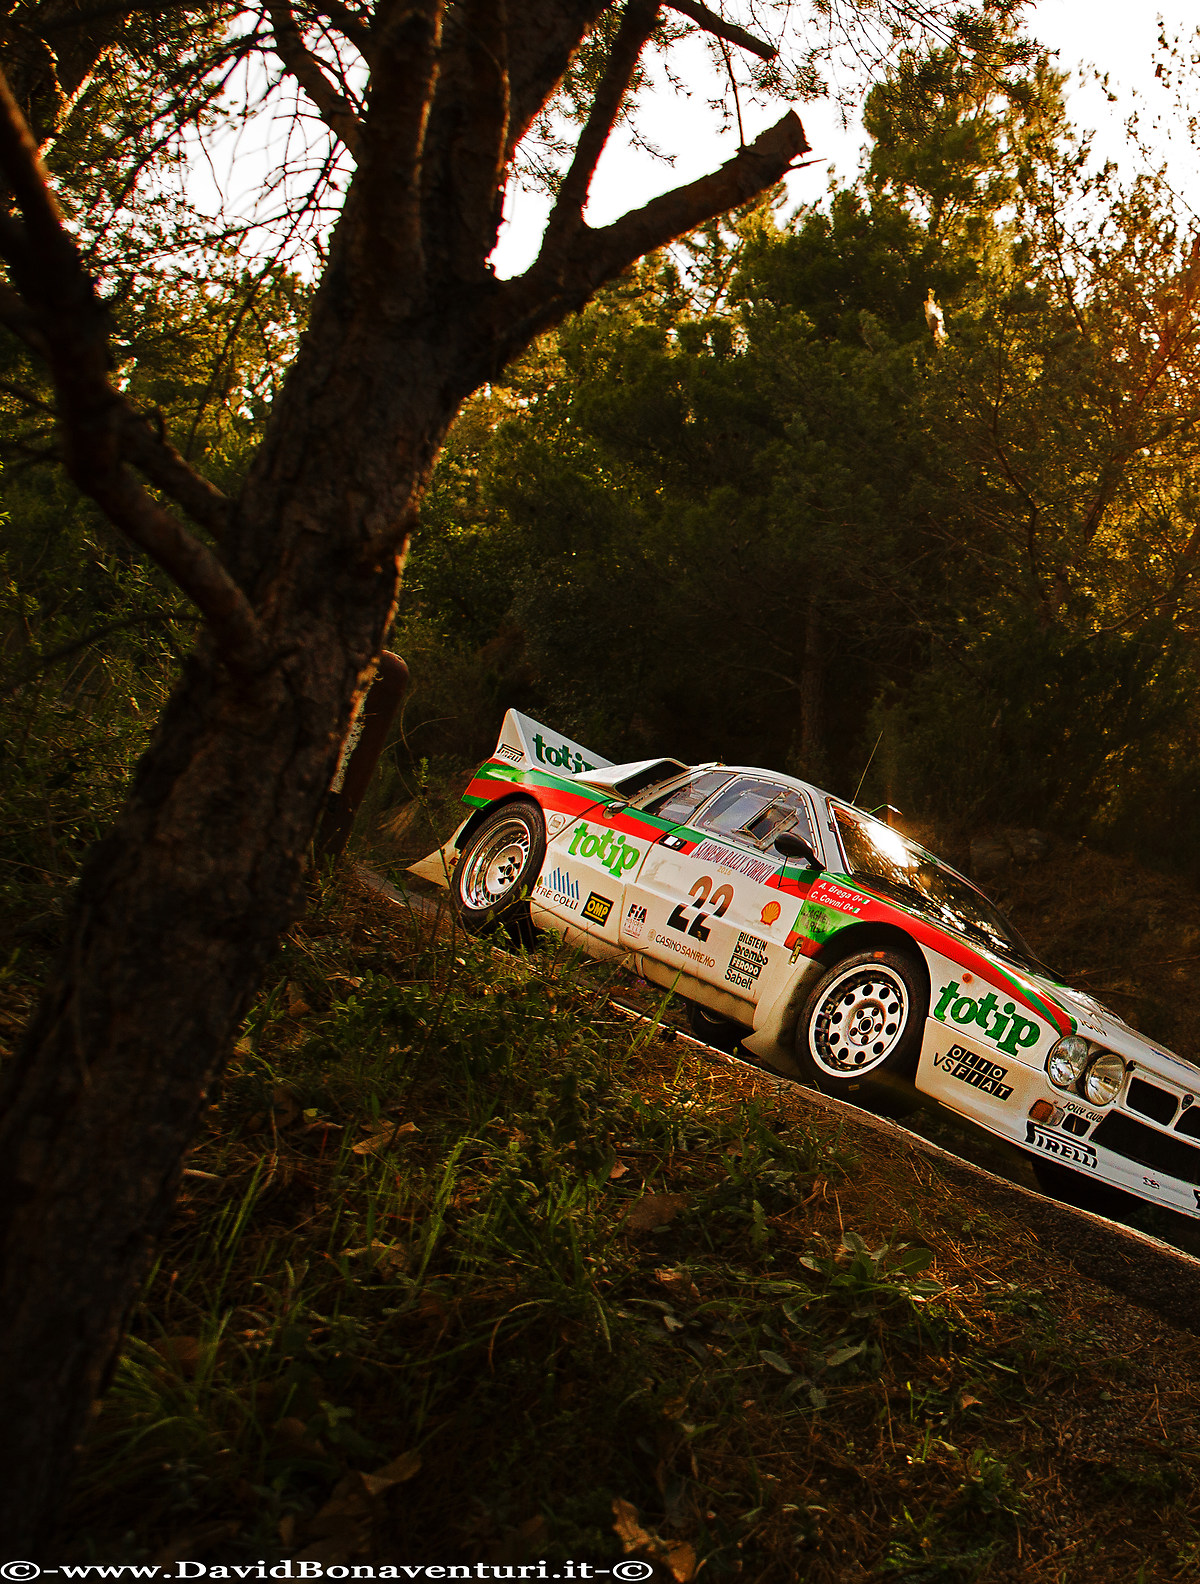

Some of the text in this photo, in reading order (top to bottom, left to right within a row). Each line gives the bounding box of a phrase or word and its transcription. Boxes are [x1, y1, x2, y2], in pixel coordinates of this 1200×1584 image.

[568, 822, 640, 878] totip
[716, 866, 733, 876] 2016
[535, 886, 579, 911] TRE COLLI
[819, 894, 845, 908] Covini
[828, 885, 852, 899] Brega
[586, 899, 609, 918] OMP
[666, 875, 734, 943] 22
[733, 941, 769, 966] brembo
[737, 931, 768, 952] BILSTEIN
[731, 956, 759, 976] FERODO
[724, 968, 754, 991] Sabelt
[933, 980, 1041, 1057] totip
[950, 1046, 1005, 1080] OLIO
[933, 1052, 1011, 1099] VS FIAT
[1063, 1101, 1104, 1123] JOLLY CLUB
[1025, 1119, 1098, 1170] PIRELLI
